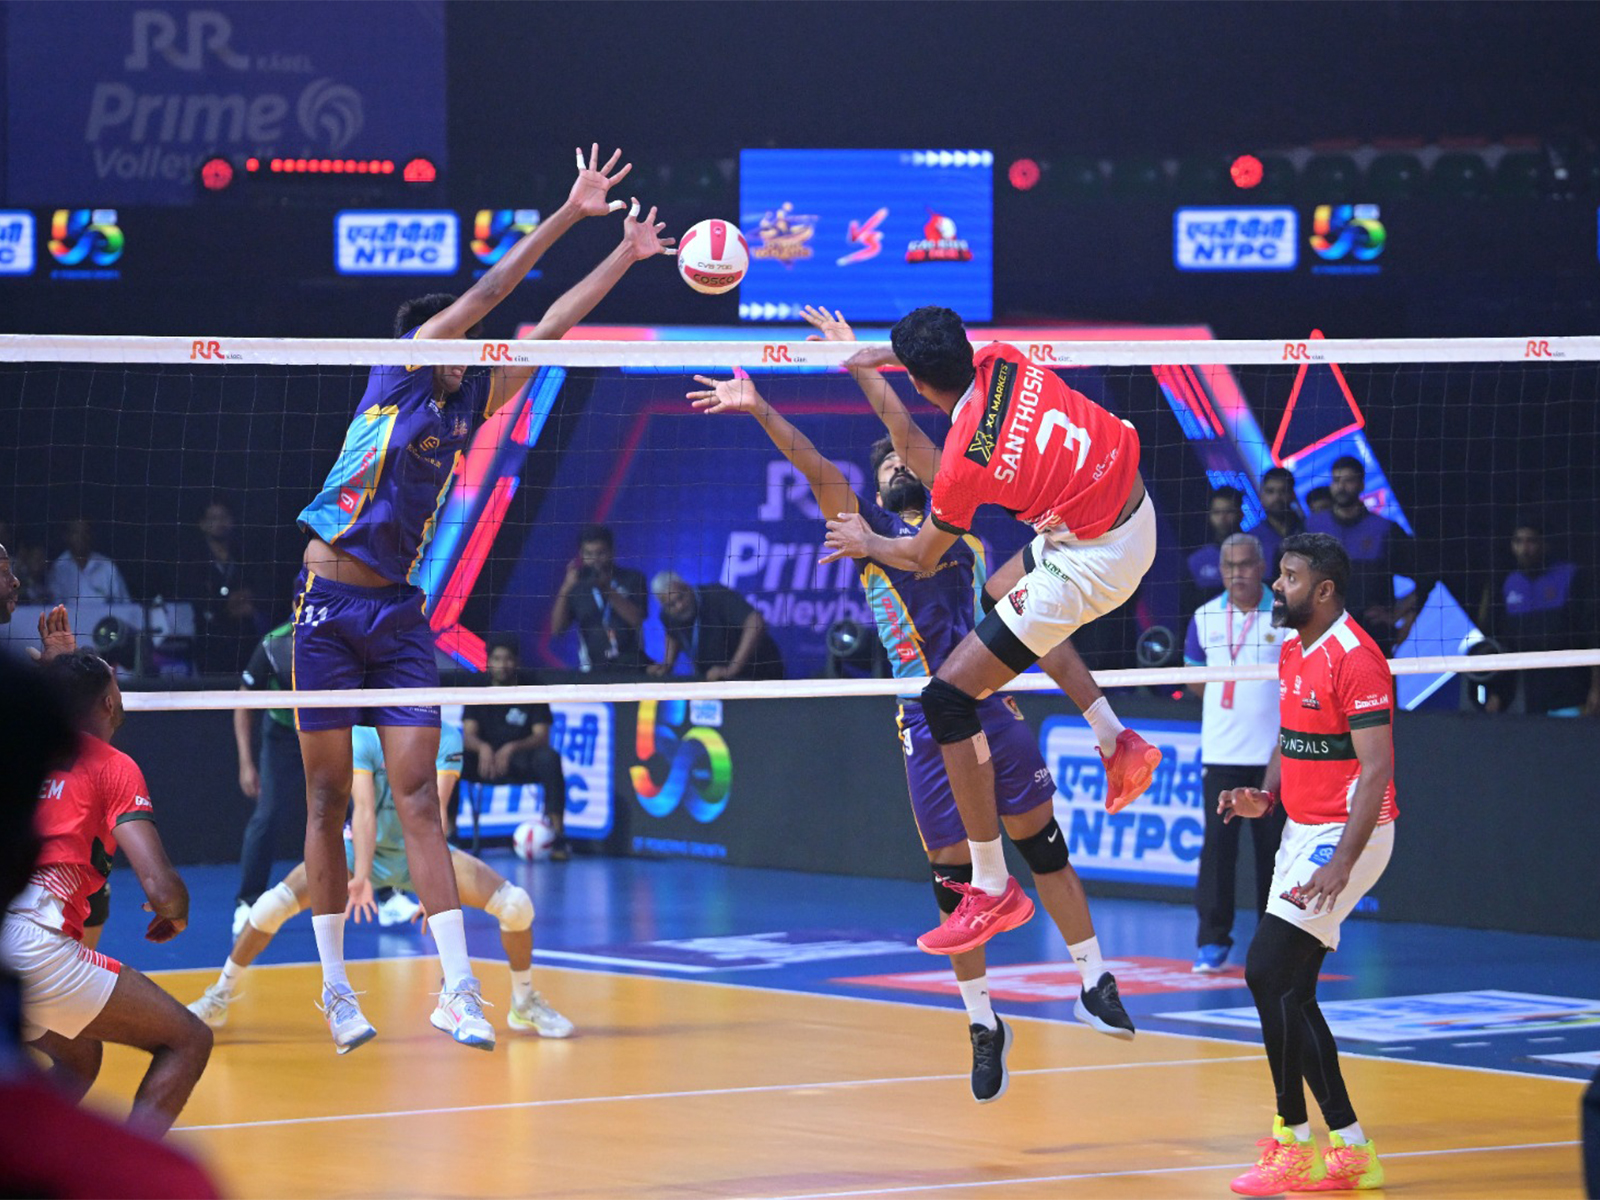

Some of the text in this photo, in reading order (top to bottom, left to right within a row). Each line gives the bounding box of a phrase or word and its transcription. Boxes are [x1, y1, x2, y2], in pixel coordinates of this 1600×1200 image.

[125, 9, 249, 71] RR
[85, 81, 288, 143] Prime
[355, 246, 440, 264] NTPC
[1194, 242, 1278, 260] NTPC
[693, 273, 735, 285] COSCO
[190, 340, 225, 360] RR
[480, 342, 513, 362] RR
[761, 344, 792, 363] RR
[1028, 343, 1057, 362] RR
[1282, 342, 1310, 361] RR
[1524, 340, 1552, 358] RR
[985, 363, 1009, 429] XA MARKETS
[994, 365, 1045, 484] SANTHOSH
[1035, 408, 1092, 476] 3
[1068, 808, 1204, 862] NTPC
